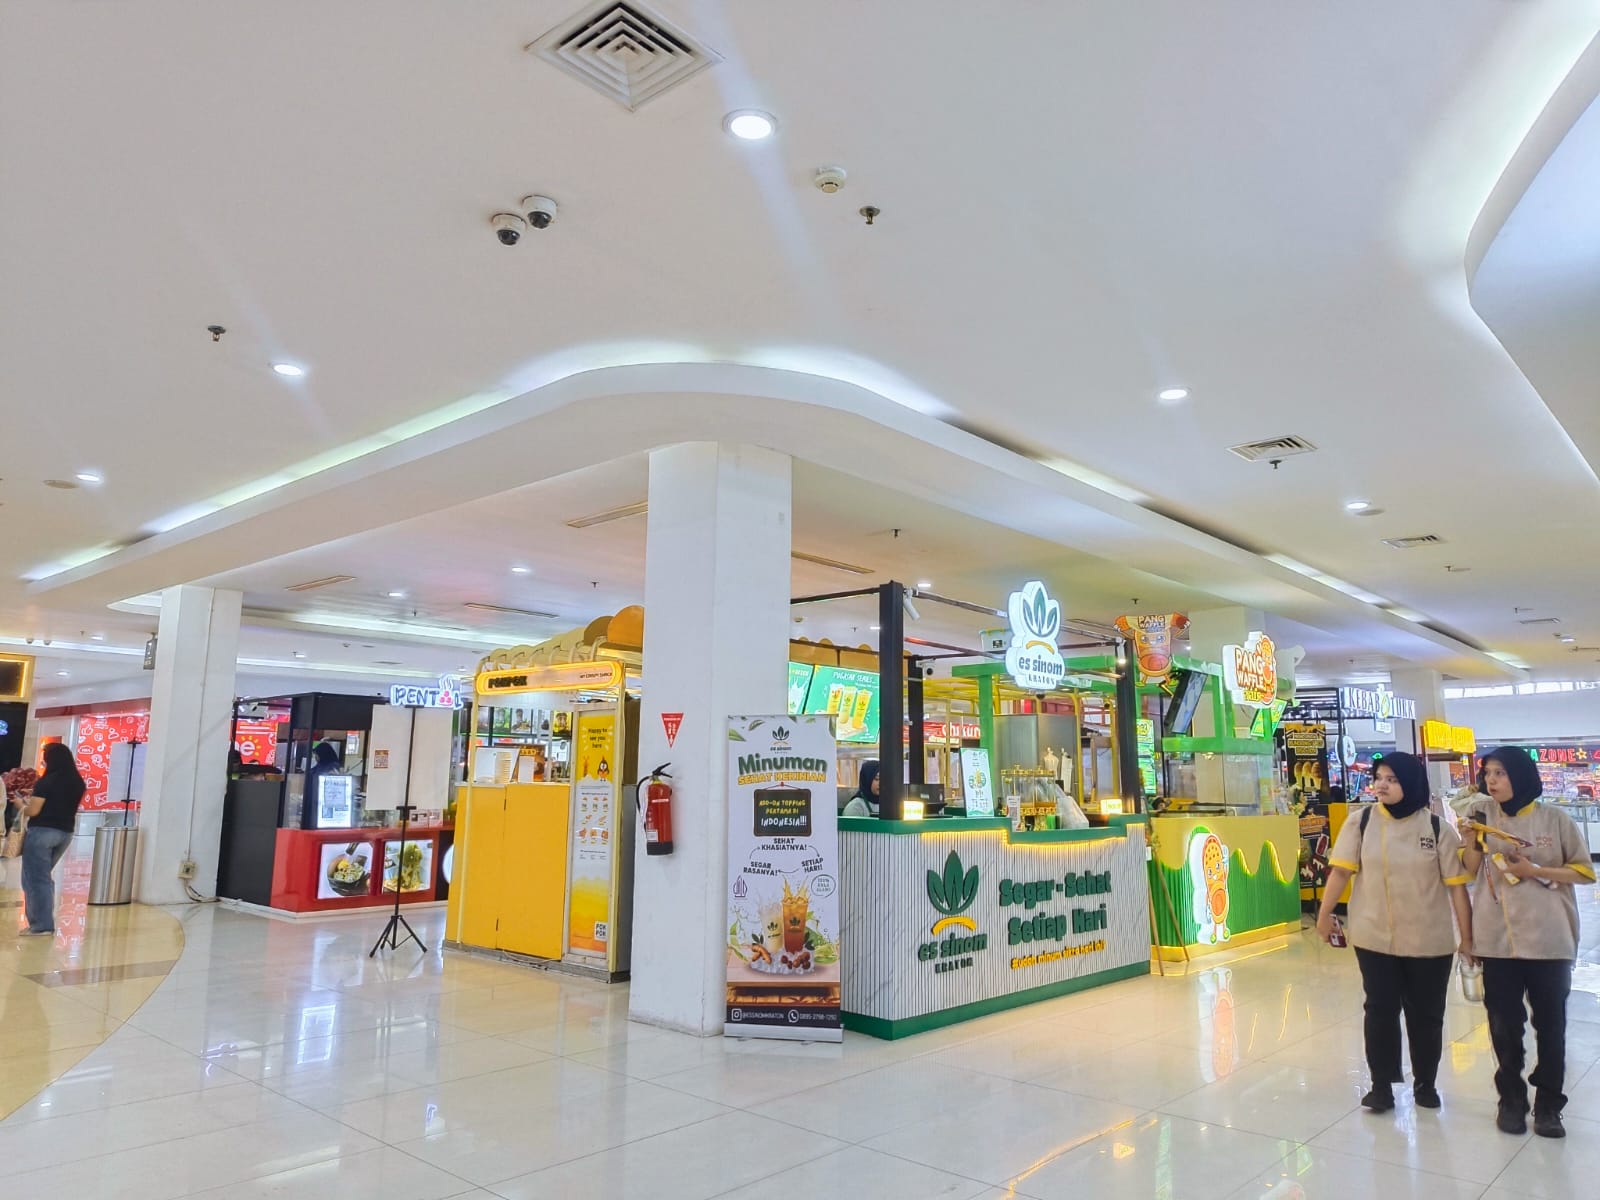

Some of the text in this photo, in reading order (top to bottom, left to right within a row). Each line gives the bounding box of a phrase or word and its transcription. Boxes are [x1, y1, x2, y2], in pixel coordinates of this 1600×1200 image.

[1018, 654, 1063, 676] es sinom
[1235, 648, 1264, 676] PANG
[1236, 670, 1265, 691] WAFFLE
[737, 753, 828, 775] Minuman
[737, 772, 773, 785] SEHAT
[782, 799, 806, 807] TOPPING
[743, 866, 778, 876] RASANYA!
[750, 861, 772, 869] SEGAR
[801, 858, 824, 867] SETIAP
[1008, 903, 1107, 945] Setiap Hari
[918, 932, 988, 962] es sinom
[935, 957, 974, 974] KRATON
